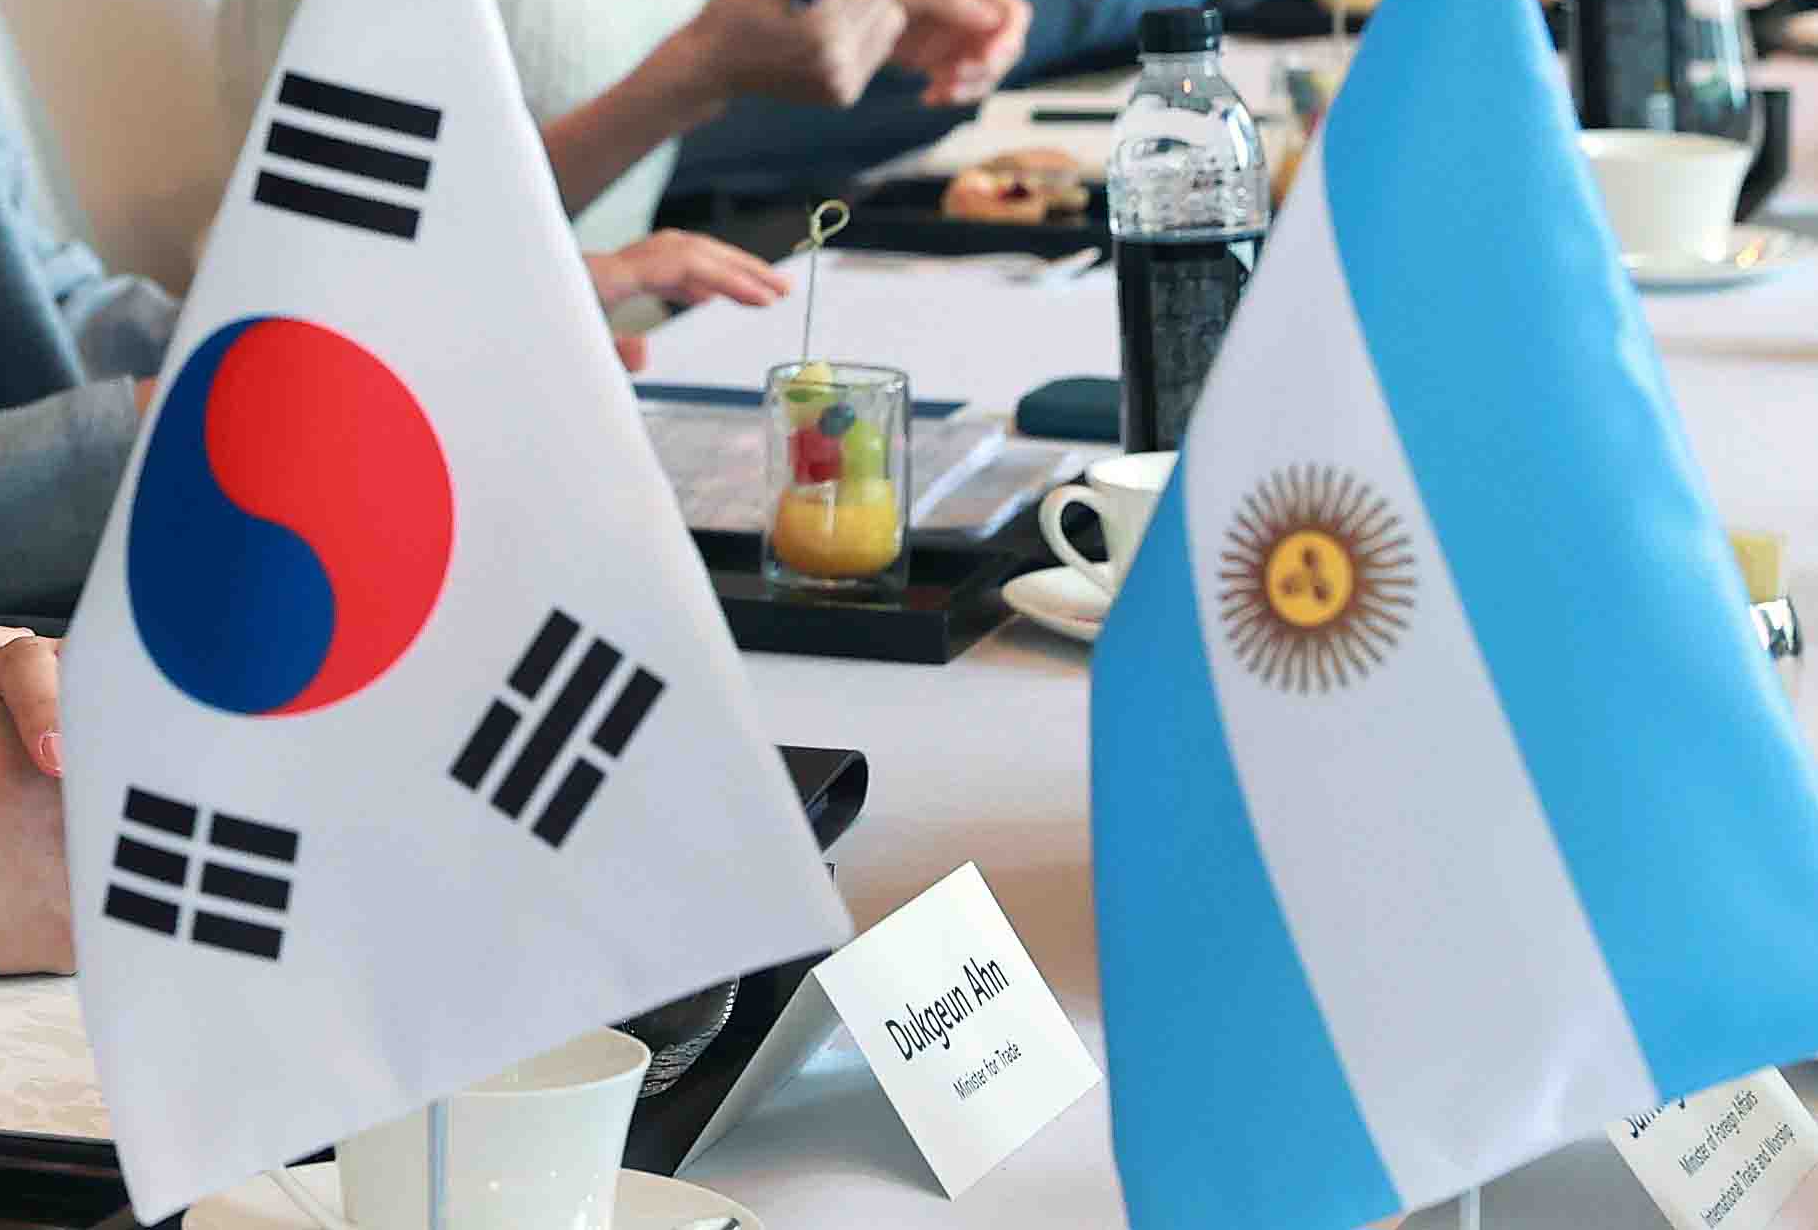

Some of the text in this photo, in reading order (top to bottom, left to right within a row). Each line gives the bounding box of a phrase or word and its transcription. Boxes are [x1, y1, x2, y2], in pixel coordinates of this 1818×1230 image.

[885, 957, 1010, 1061] Dukgeun Ahn
[953, 1041, 1022, 1099] Minister for Trade
[1678, 1144, 1710, 1178] Minister
[1710, 1111, 1741, 1143] Foreign
